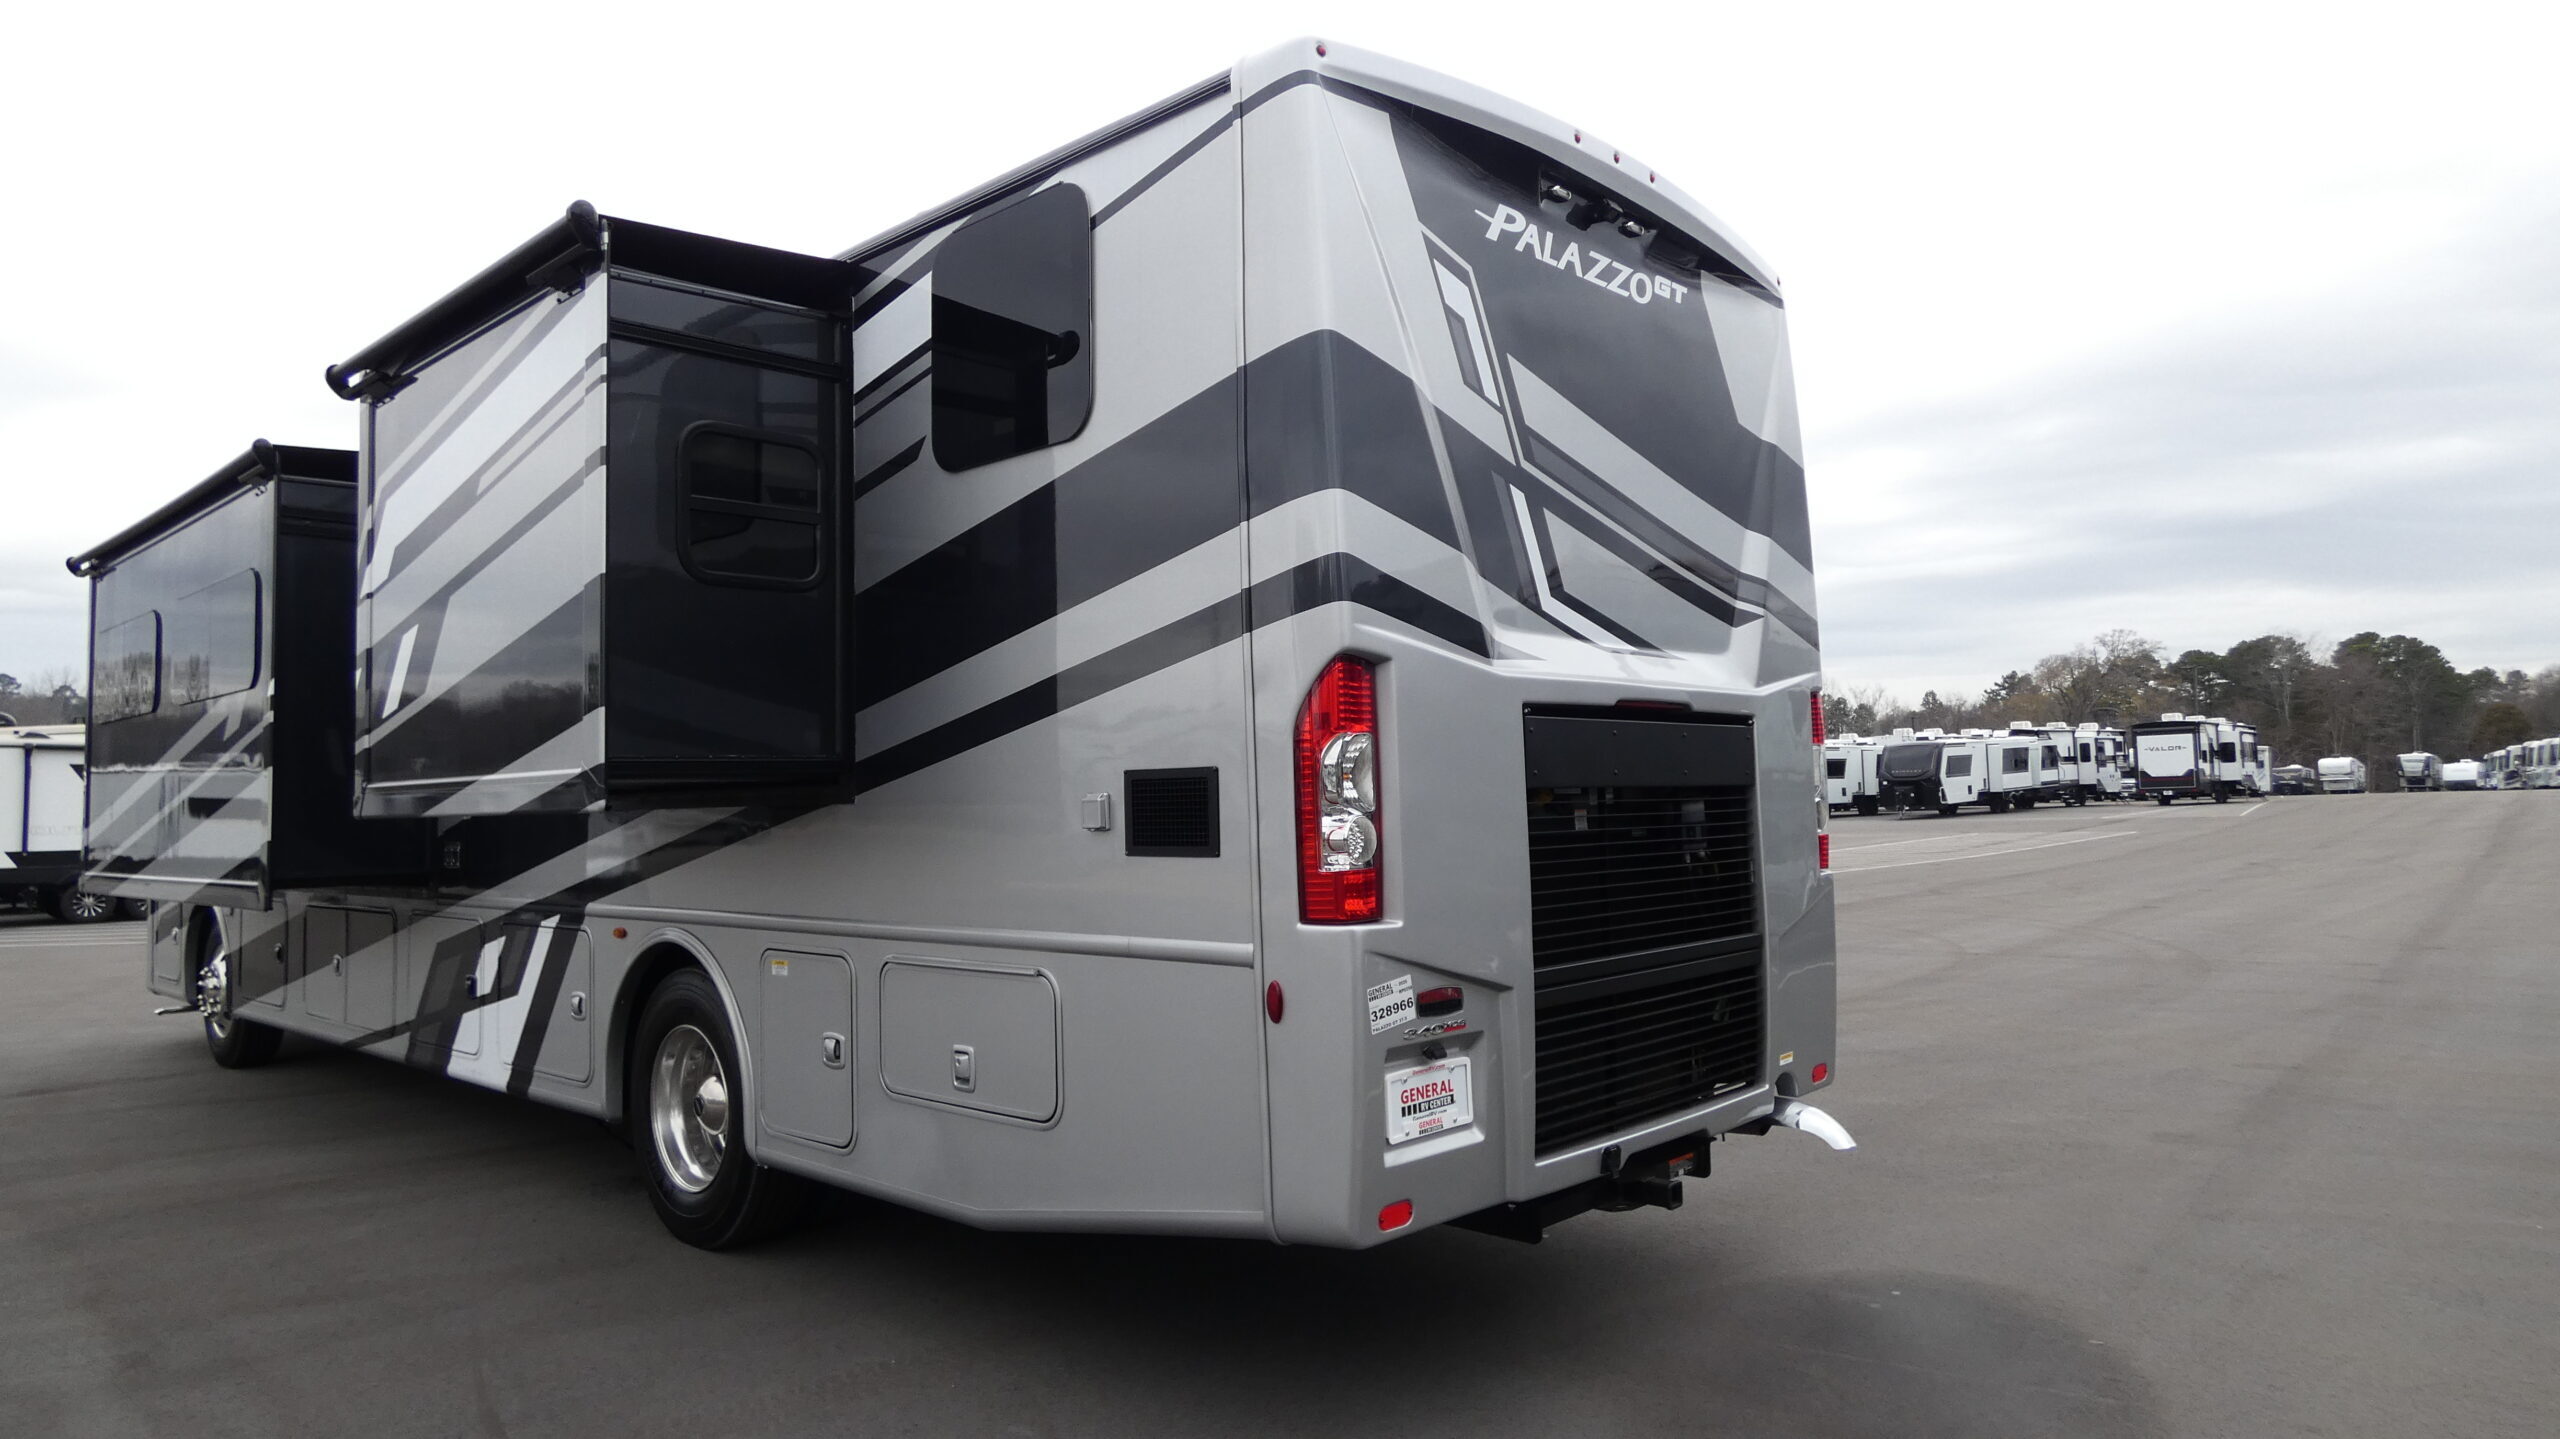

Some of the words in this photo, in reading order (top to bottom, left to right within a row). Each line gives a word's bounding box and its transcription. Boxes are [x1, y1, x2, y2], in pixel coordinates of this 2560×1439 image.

[1475, 203, 1652, 304] PALAZZO
[1654, 275, 1688, 304] GT
[1368, 983, 1393, 997] GENERAL
[1371, 997, 1414, 1022] 328966
[1400, 1079, 1454, 1104] GENERAL
[1420, 1102, 1430, 1112] RV
[1430, 1096, 1452, 1109] CENTER
[1418, 1116, 1443, 1129] GENERAL
